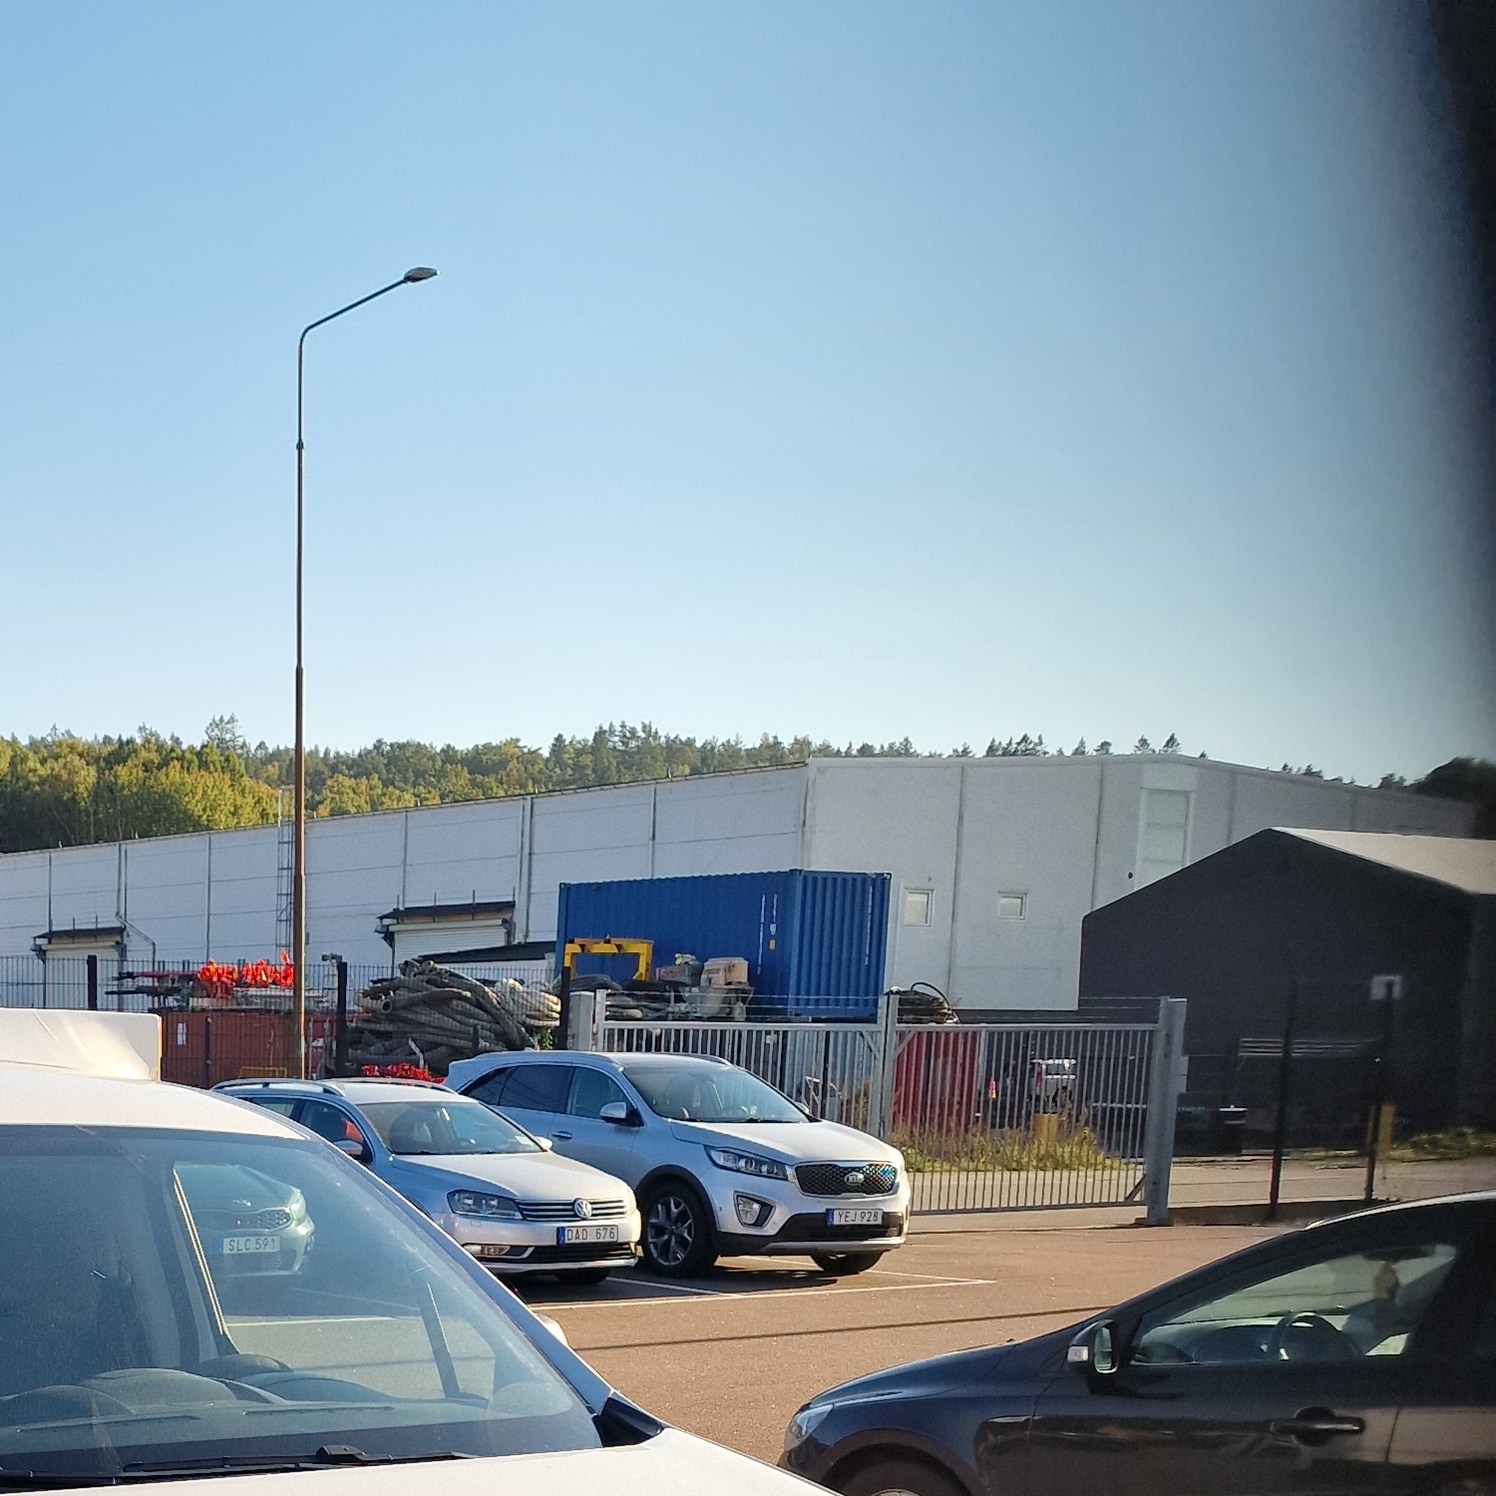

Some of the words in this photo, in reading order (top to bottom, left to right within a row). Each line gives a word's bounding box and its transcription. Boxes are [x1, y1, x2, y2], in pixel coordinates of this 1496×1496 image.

[838, 1211, 857, 1223] YEJ
[566, 1228, 588, 1241] DAD
[595, 1227, 615, 1240] 676
[228, 1239, 251, 1252] SLC
[255, 1237, 275, 1250] 591
